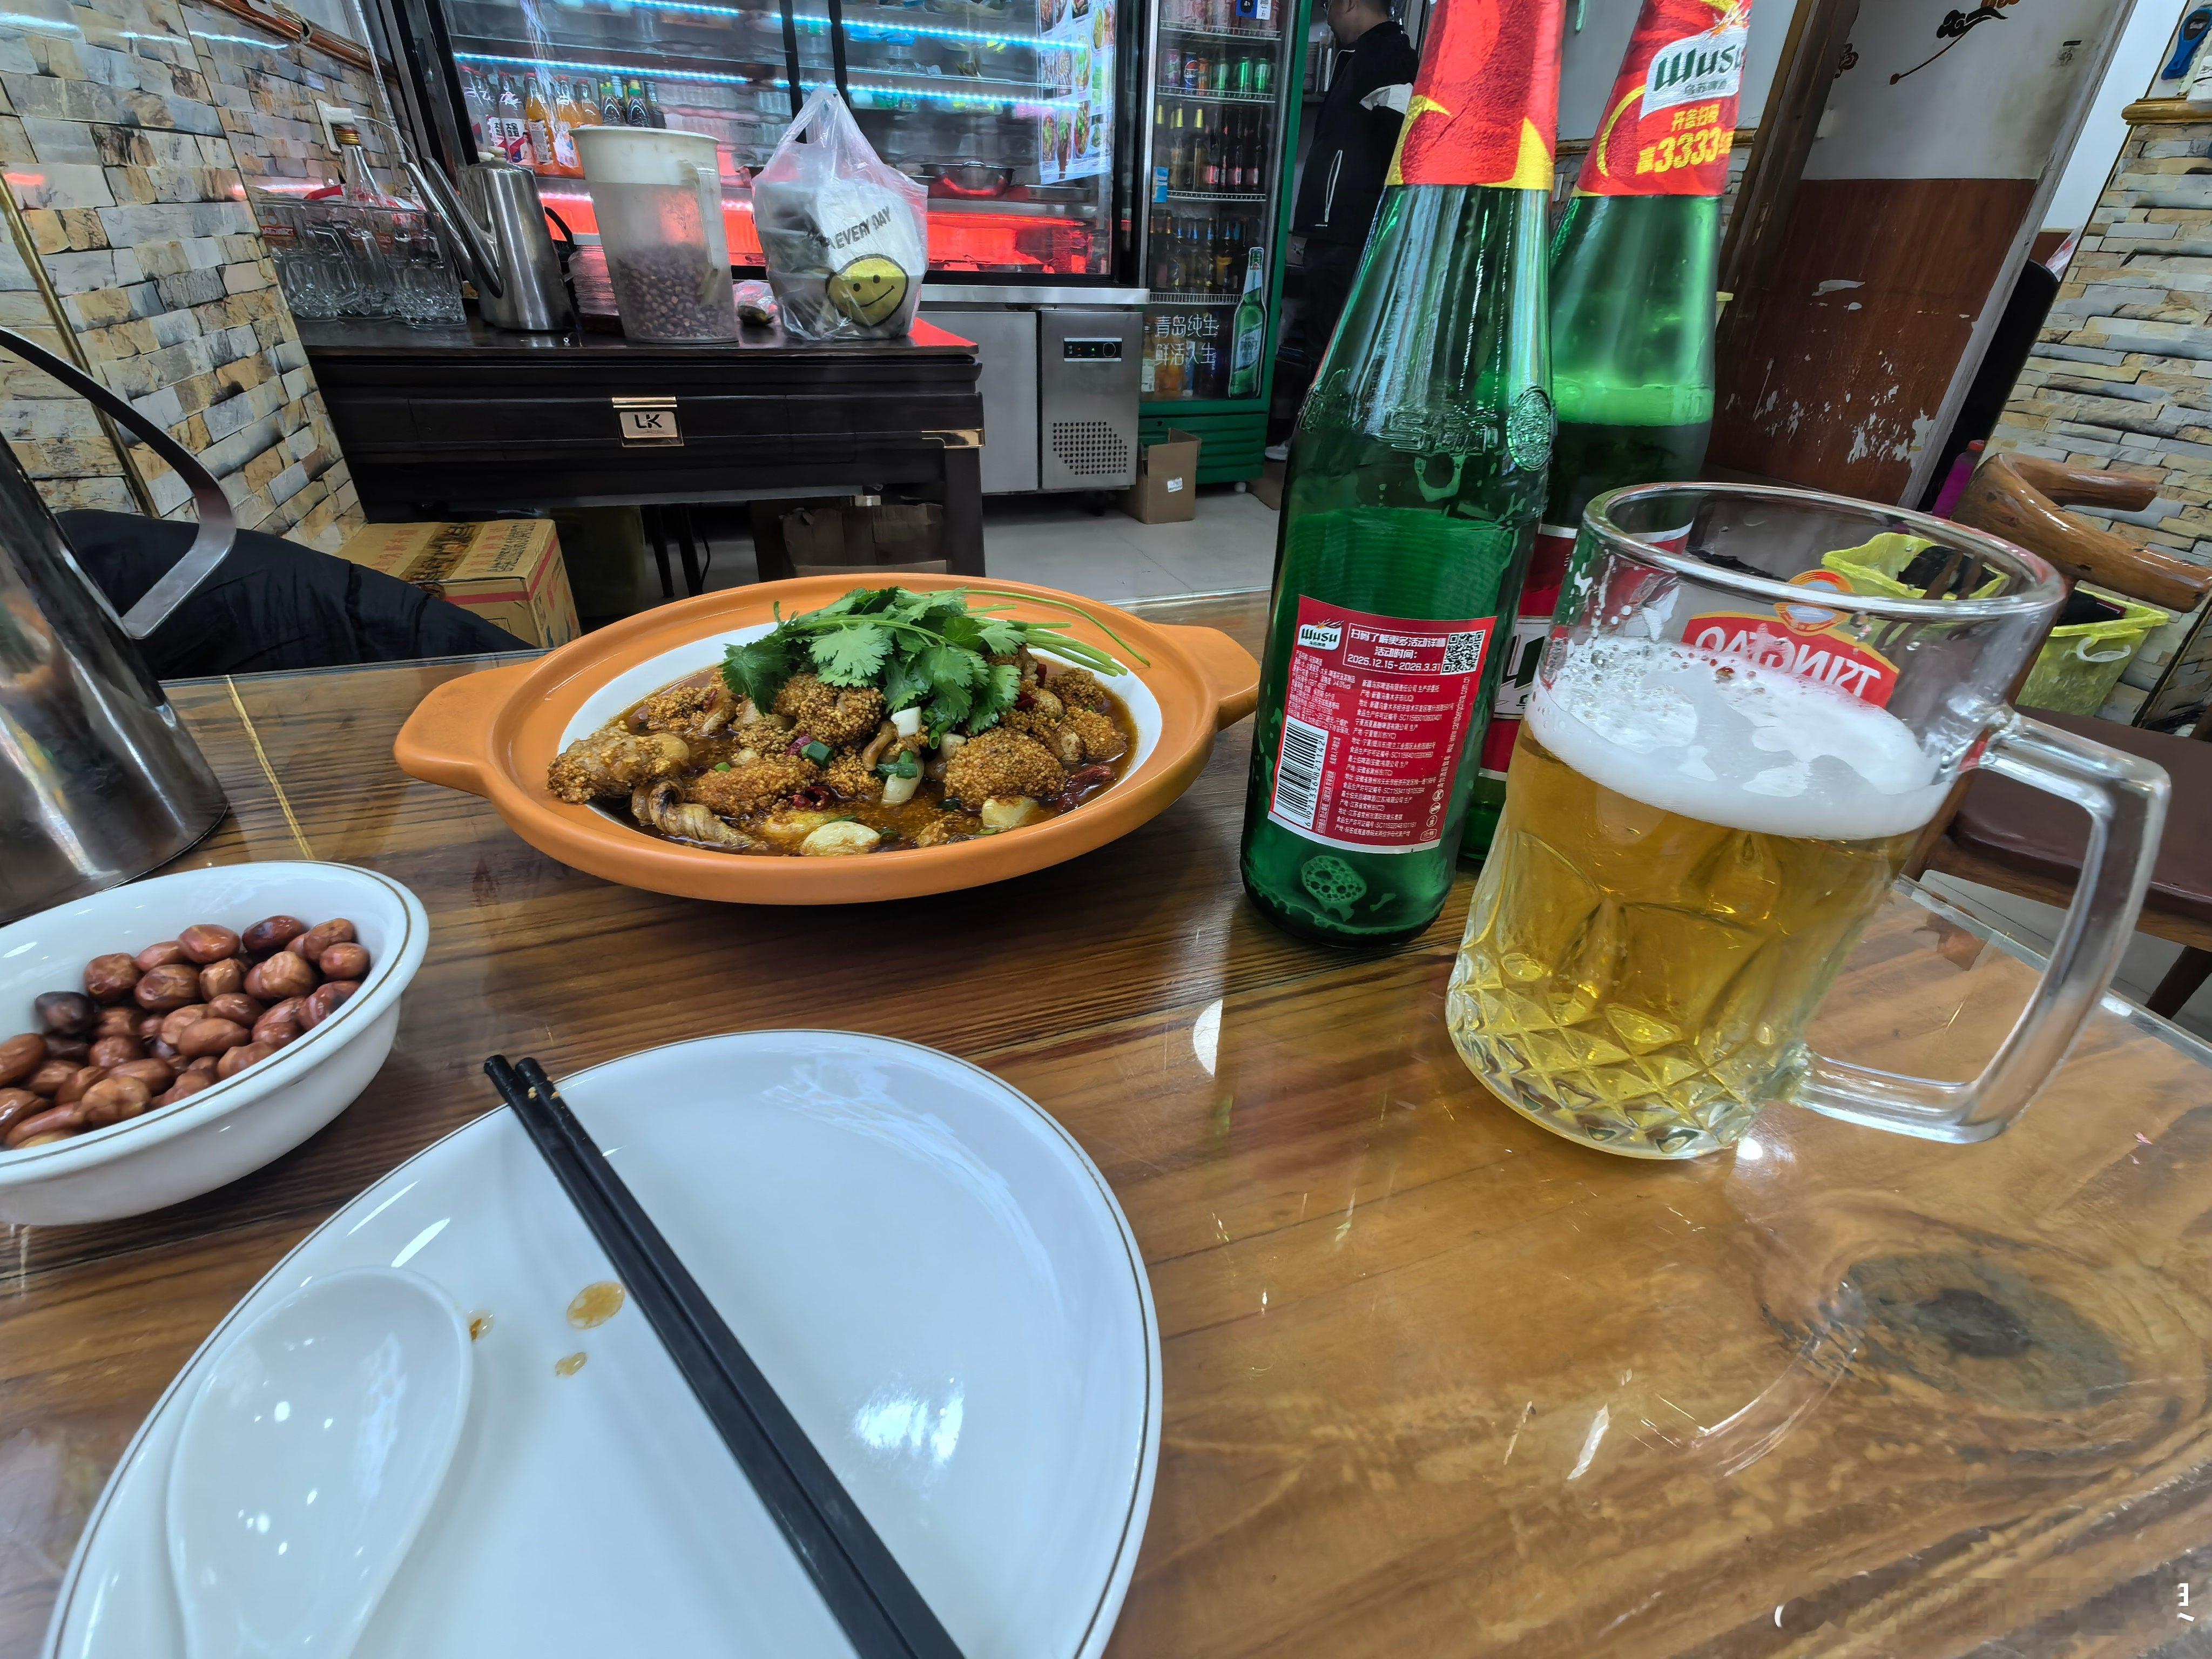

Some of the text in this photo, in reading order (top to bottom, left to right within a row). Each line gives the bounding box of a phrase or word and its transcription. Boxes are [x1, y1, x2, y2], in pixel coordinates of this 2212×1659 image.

[835, 219, 870, 249] EVERY
[871, 206, 891, 230] DAY
[1155, 314, 1218, 338] 青岛纯生
[635, 414, 662, 428] LK
[1351, 629, 1447, 648] 扫码了解更多活动详情
